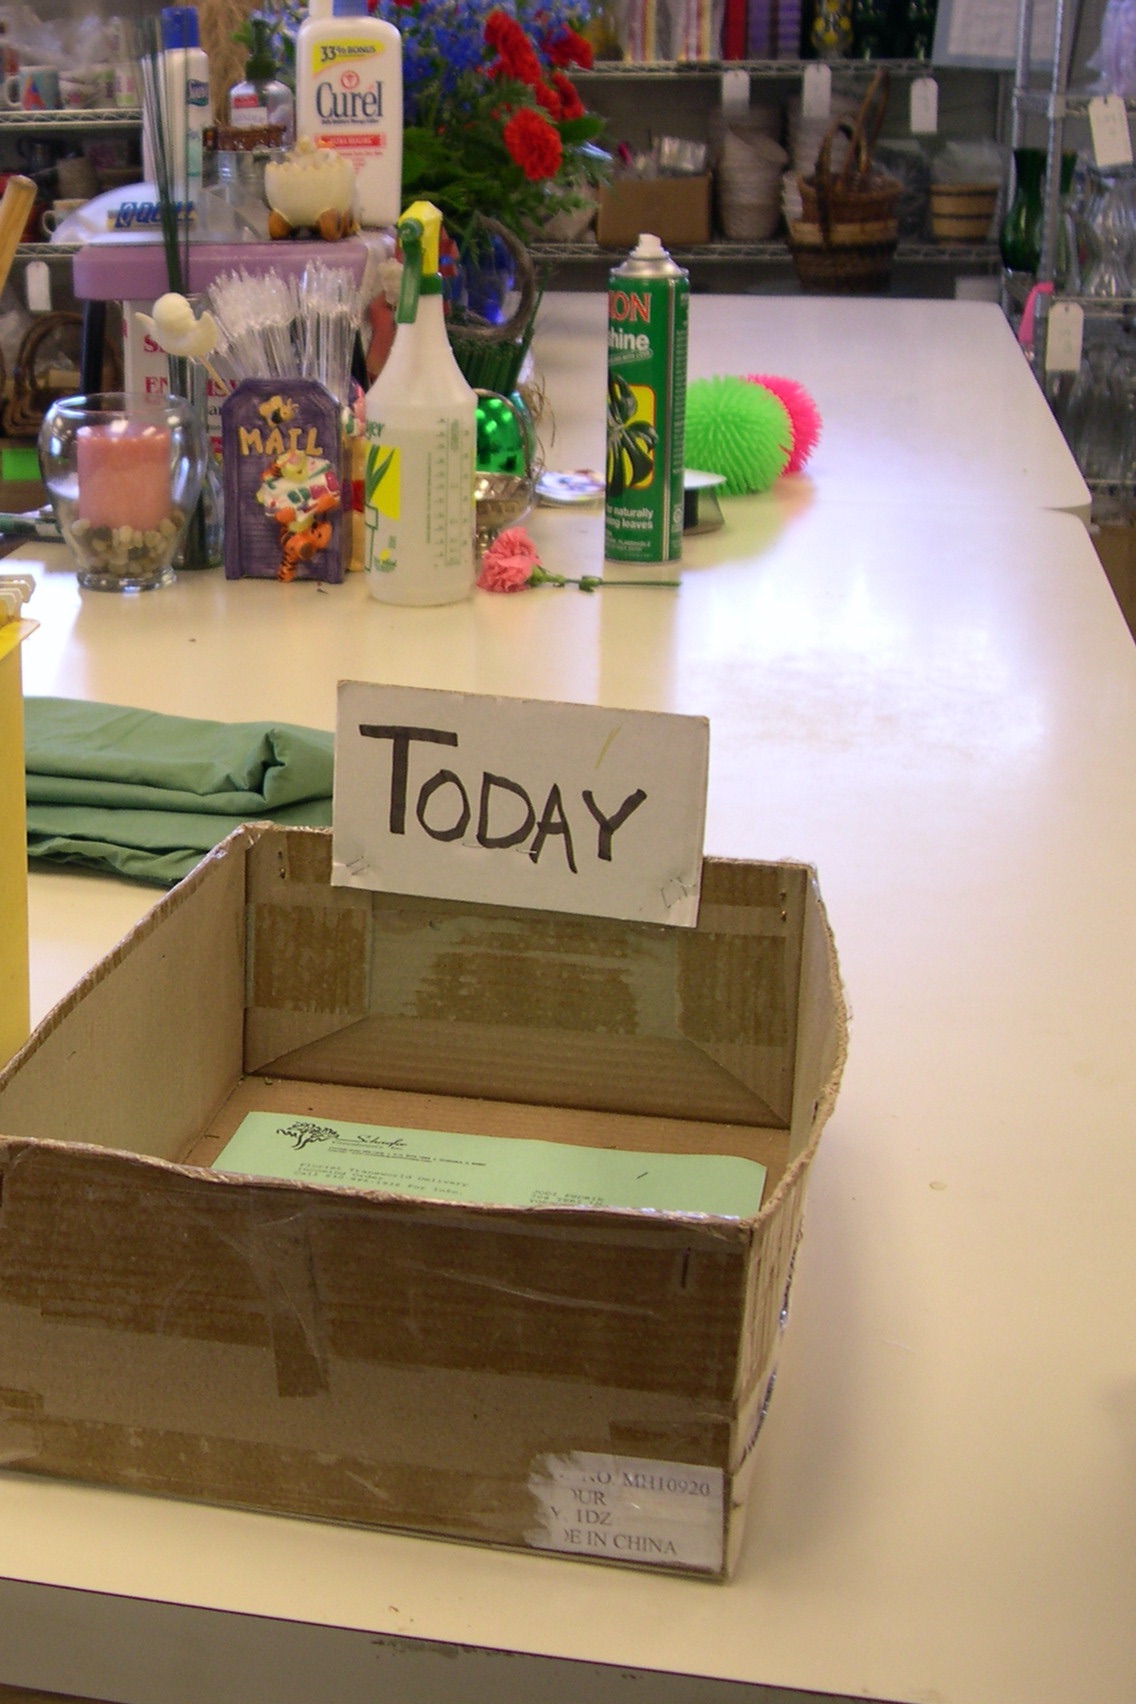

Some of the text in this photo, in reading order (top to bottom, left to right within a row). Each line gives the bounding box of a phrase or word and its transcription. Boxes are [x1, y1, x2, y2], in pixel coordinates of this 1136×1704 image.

[608, 290, 652, 323] ON
[238, 426, 324, 456] MAIL
[622, 517, 654, 530] leaves
[359, 724, 647, 873] TODAY
[586, 1531, 607, 1548] IN
[613, 1534, 678, 1556] CHINA
